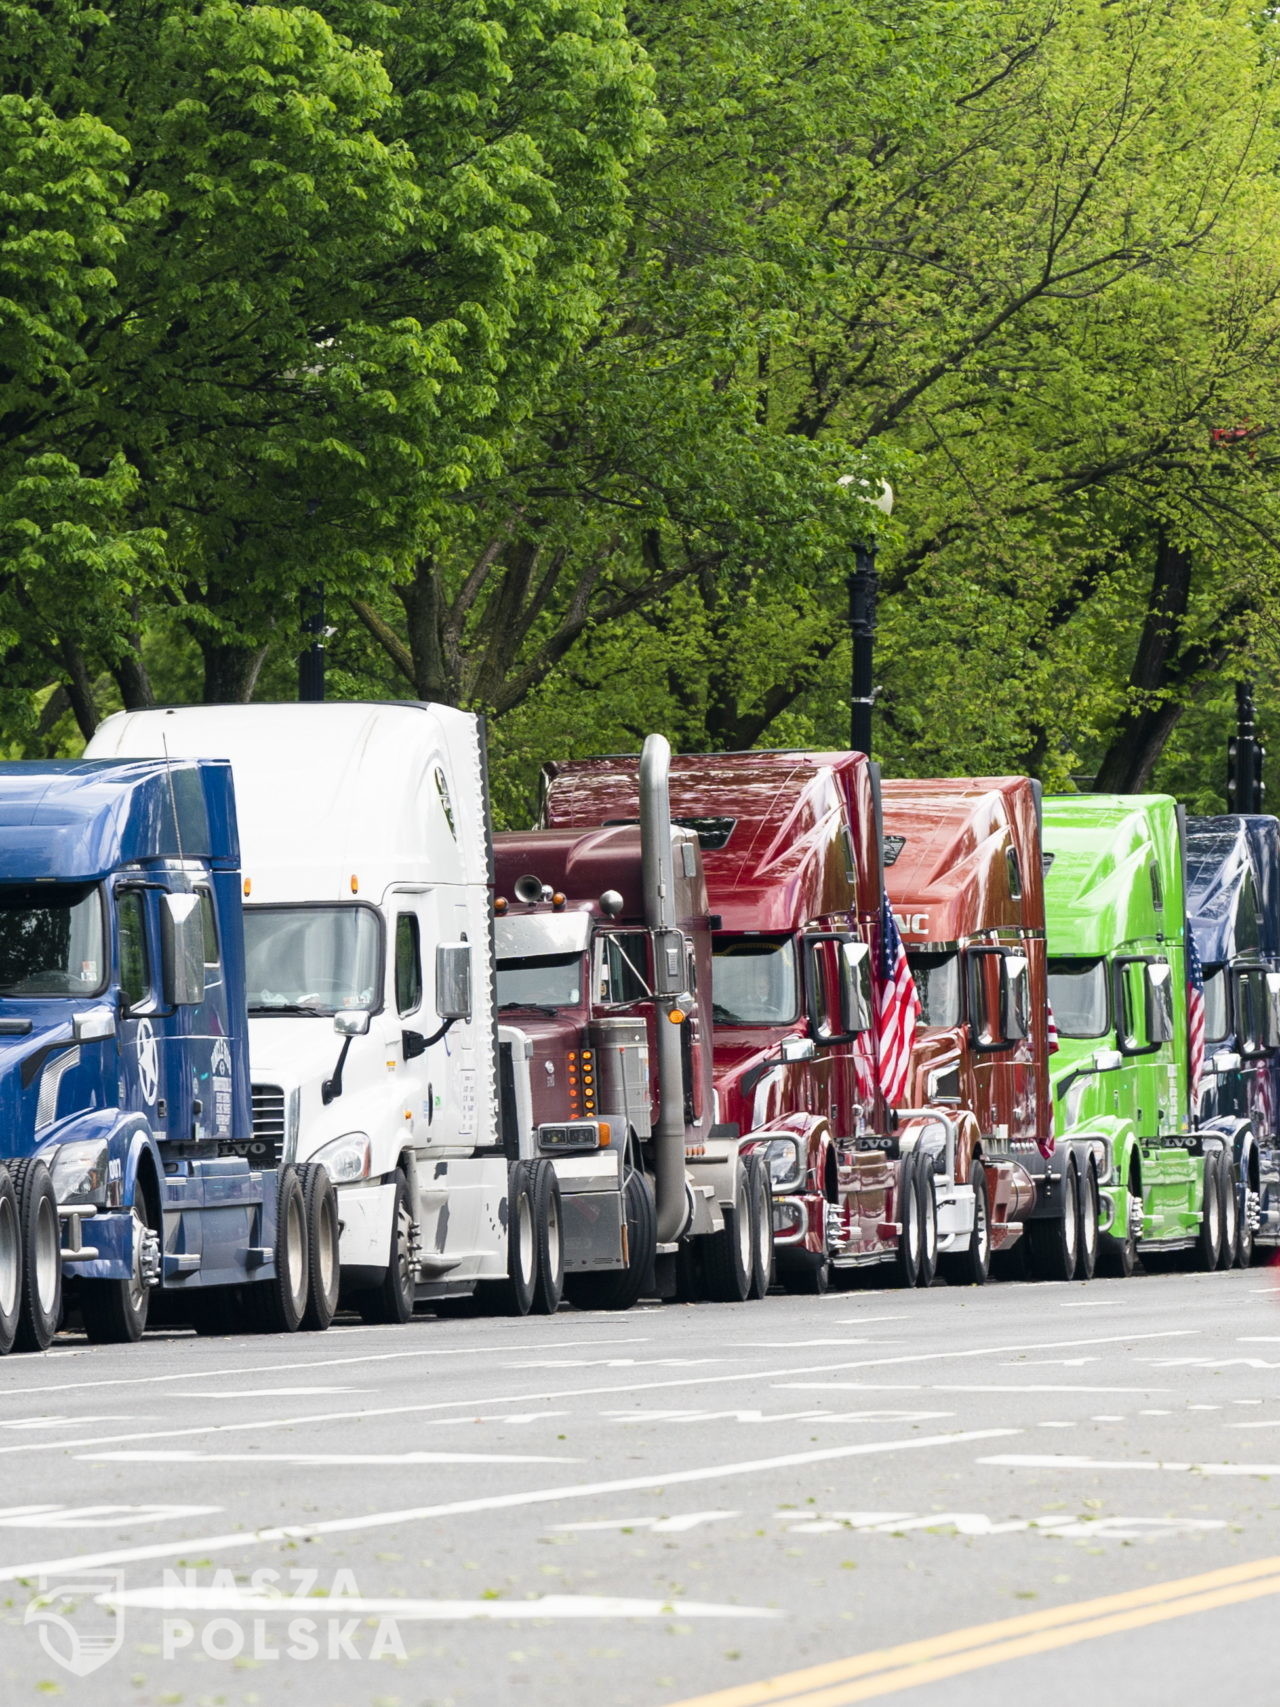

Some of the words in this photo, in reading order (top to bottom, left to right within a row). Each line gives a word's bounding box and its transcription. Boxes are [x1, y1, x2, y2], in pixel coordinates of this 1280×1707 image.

[892, 913, 930, 935] NC
[220, 1142, 266, 1155] LVO
[860, 1138, 892, 1149] LVO
[1165, 1138, 1197, 1147] LVO
